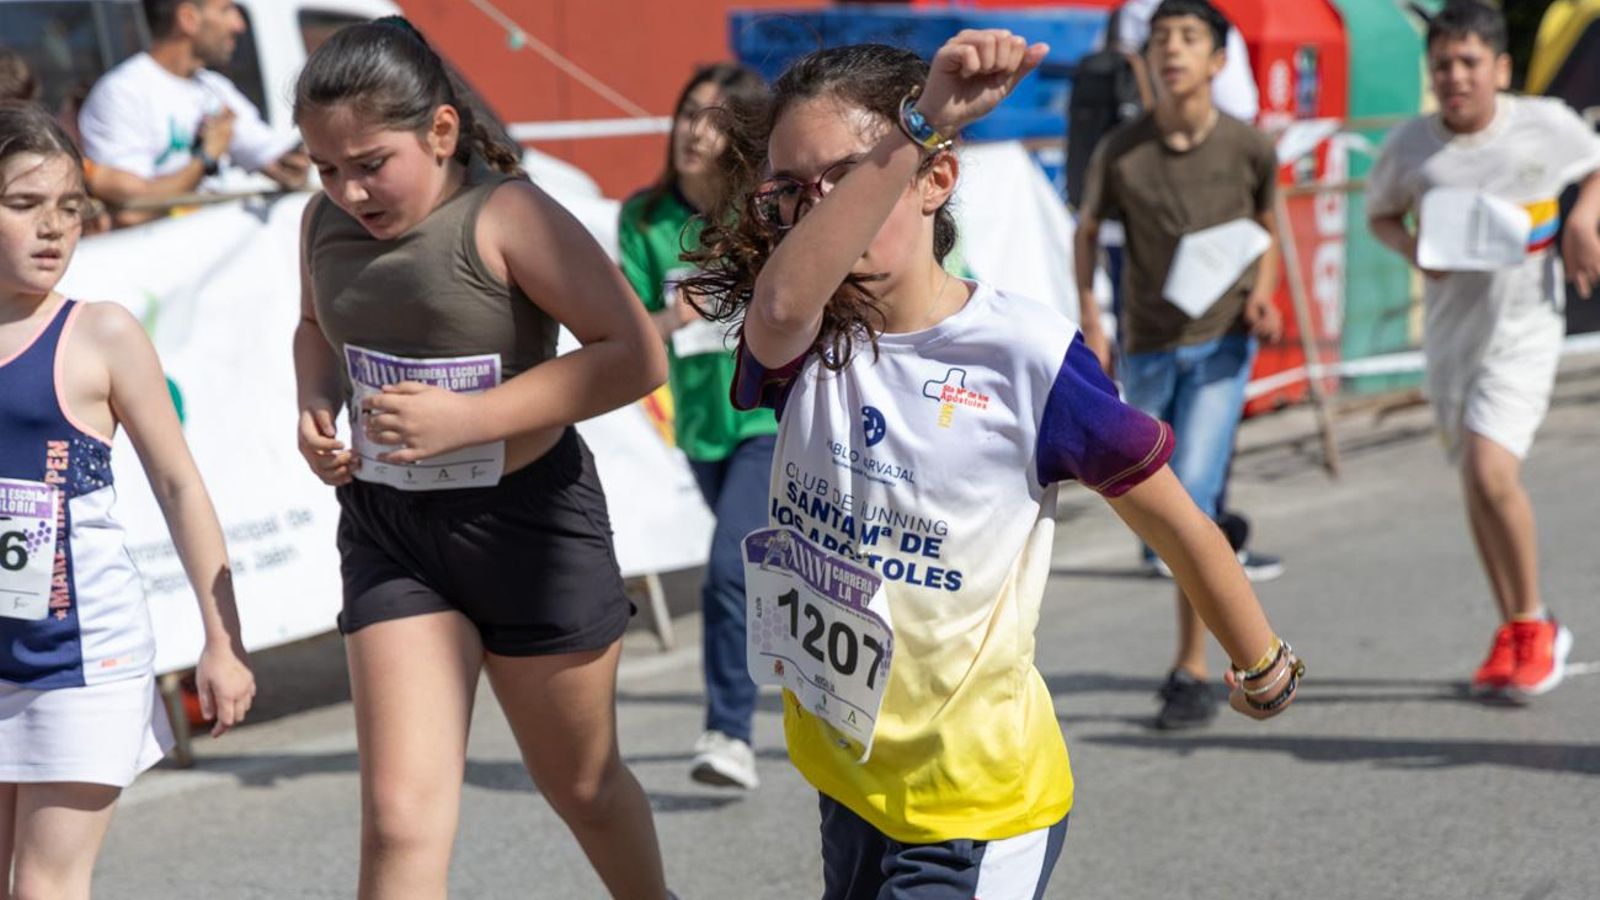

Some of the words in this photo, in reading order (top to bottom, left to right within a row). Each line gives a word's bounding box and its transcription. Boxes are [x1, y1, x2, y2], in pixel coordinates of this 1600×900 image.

[450, 364, 491, 378] ESCOLAR
[827, 439, 860, 463] BLO
[863, 456, 915, 485] RVAJAL
[785, 461, 829, 497] CLUB
[860, 500, 949, 538] UNNING
[786, 480, 856, 541] SANTA
[899, 532, 943, 560] DE
[809, 528, 963, 593] APÓTOLES
[832, 565, 873, 597] CARRERA
[838, 582, 852, 603] LA
[777, 587, 884, 691] 1207
